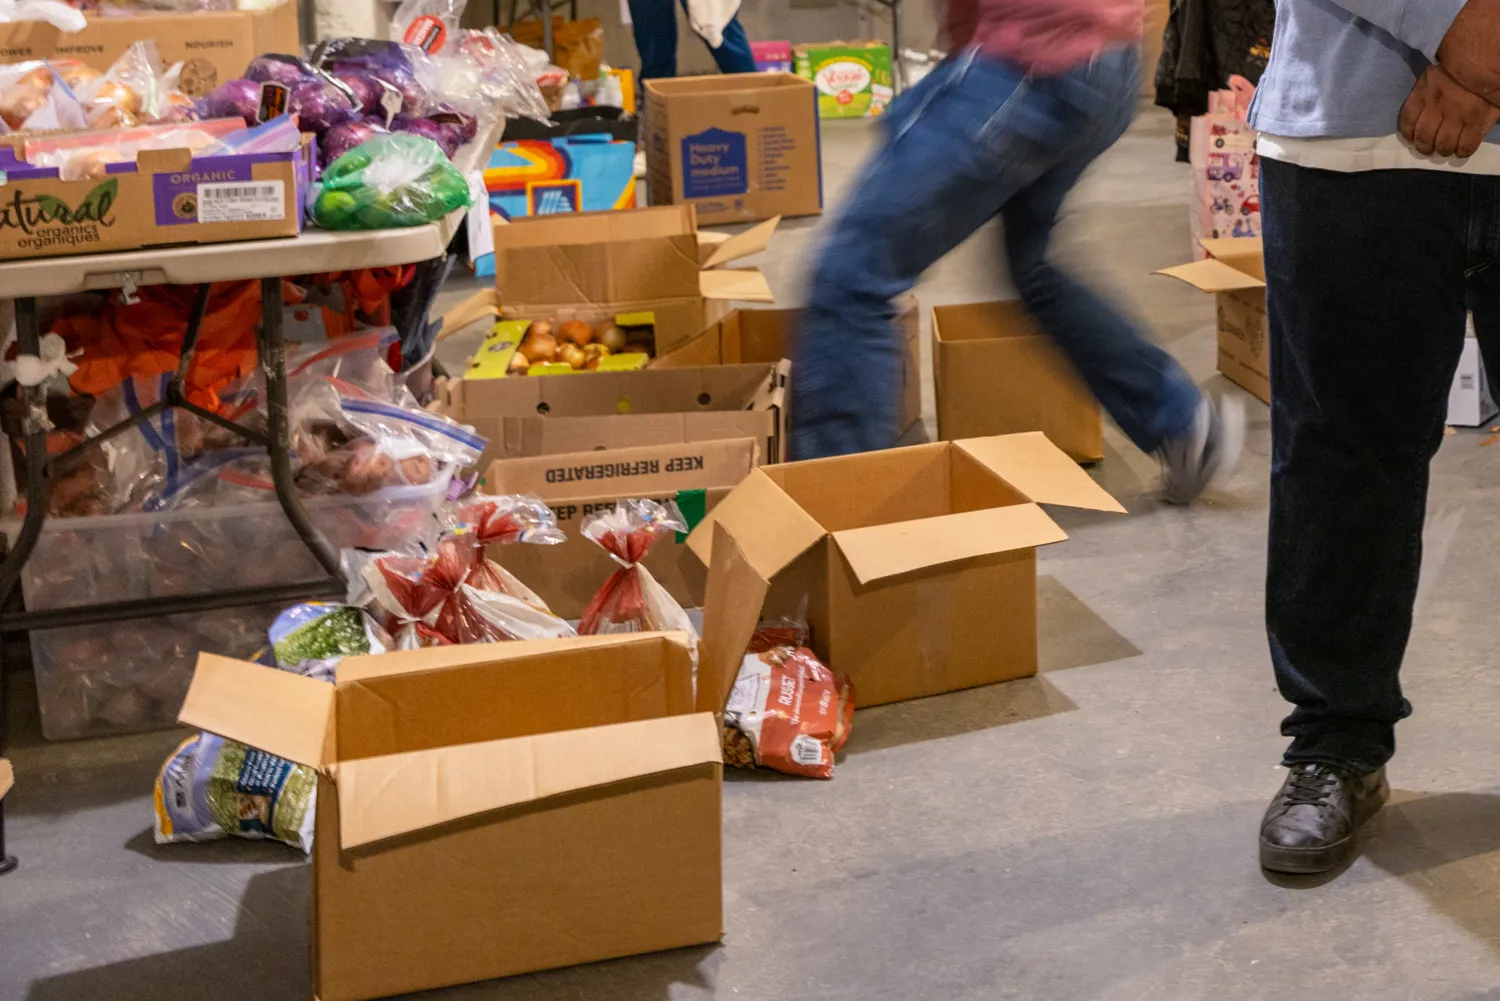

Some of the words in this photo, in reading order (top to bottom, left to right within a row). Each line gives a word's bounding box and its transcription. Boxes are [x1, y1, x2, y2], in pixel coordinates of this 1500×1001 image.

[55, 44, 105, 54] IMPROVE
[185, 39, 234, 51] NOURISH
[689, 143, 730, 155] Heavy
[690, 155, 721, 168] Duty
[170, 169, 237, 185] ORGANIC
[691, 166, 740, 178] medium
[36, 225, 98, 239] organics
[17, 233, 100, 250] organiques
[545, 459, 660, 484] REFRIGERATED
[665, 456, 704, 473] KEEP
[778, 674, 796, 706] RUSSET
